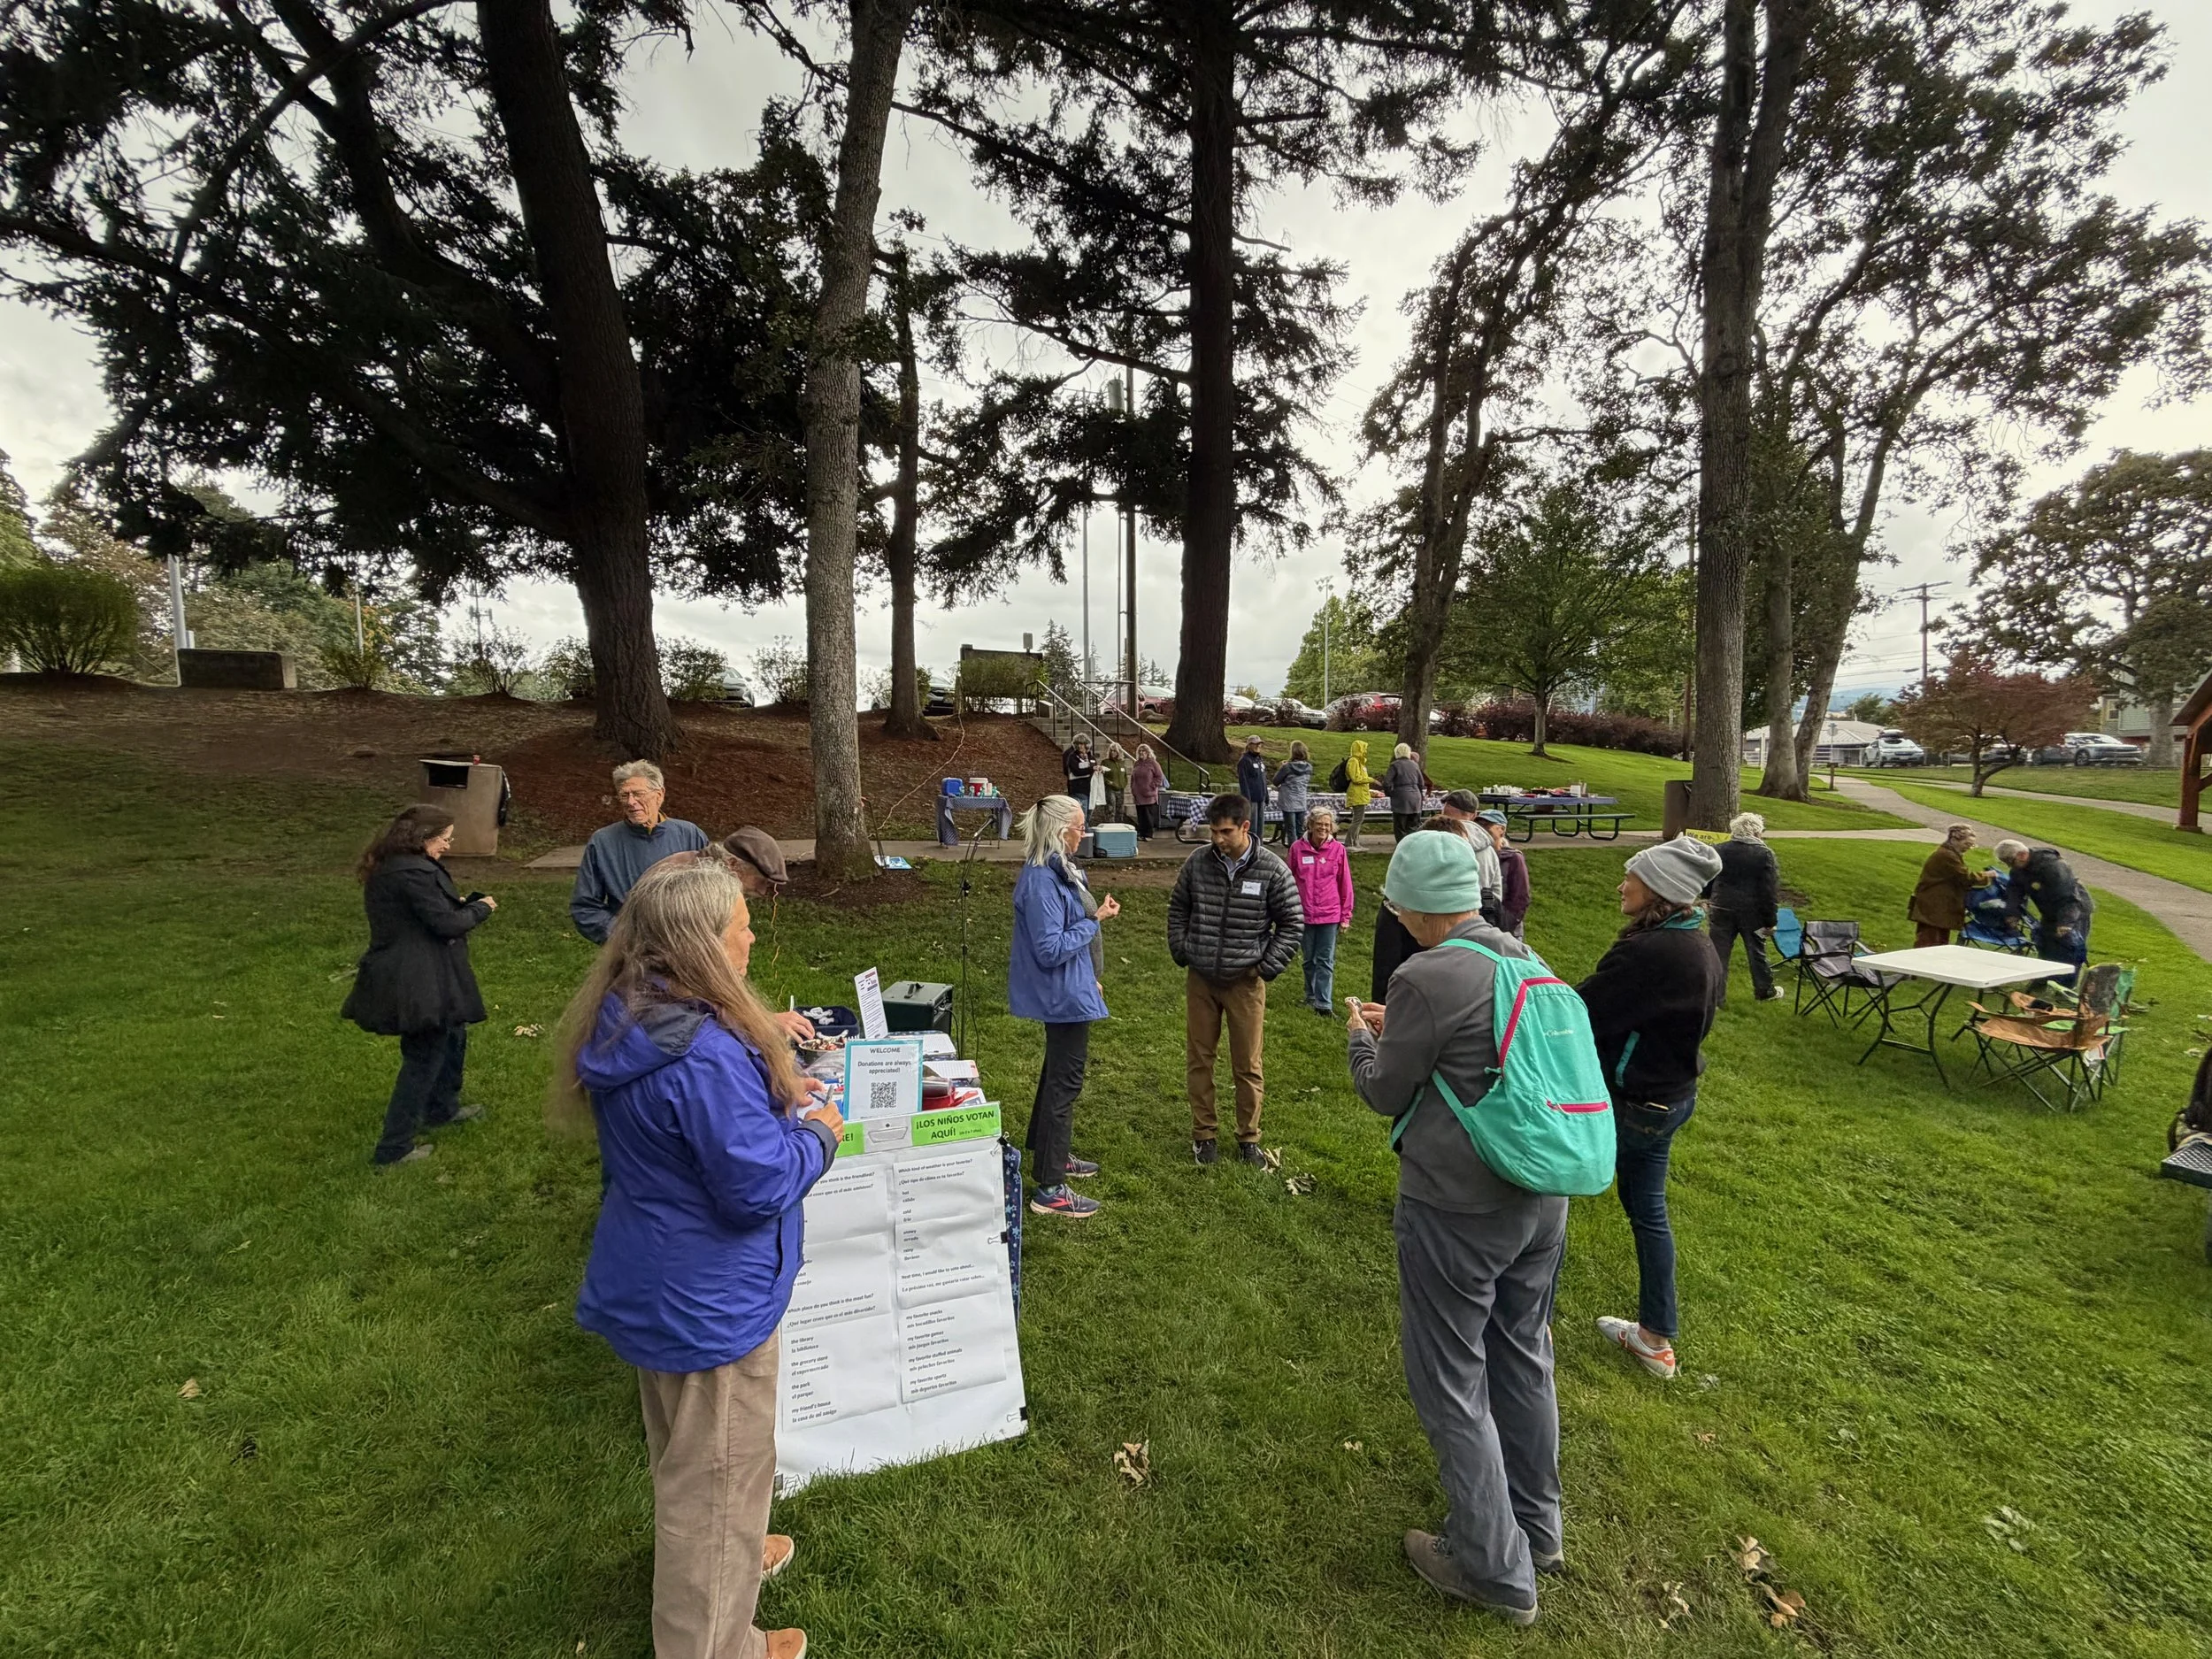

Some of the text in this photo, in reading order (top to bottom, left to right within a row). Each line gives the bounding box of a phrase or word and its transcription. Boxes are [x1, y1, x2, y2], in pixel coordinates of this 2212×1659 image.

[916, 1110, 995, 1130] ¡LOS NIÑOS VOTAN
[931, 1126, 956, 1140] AQUÍ!
